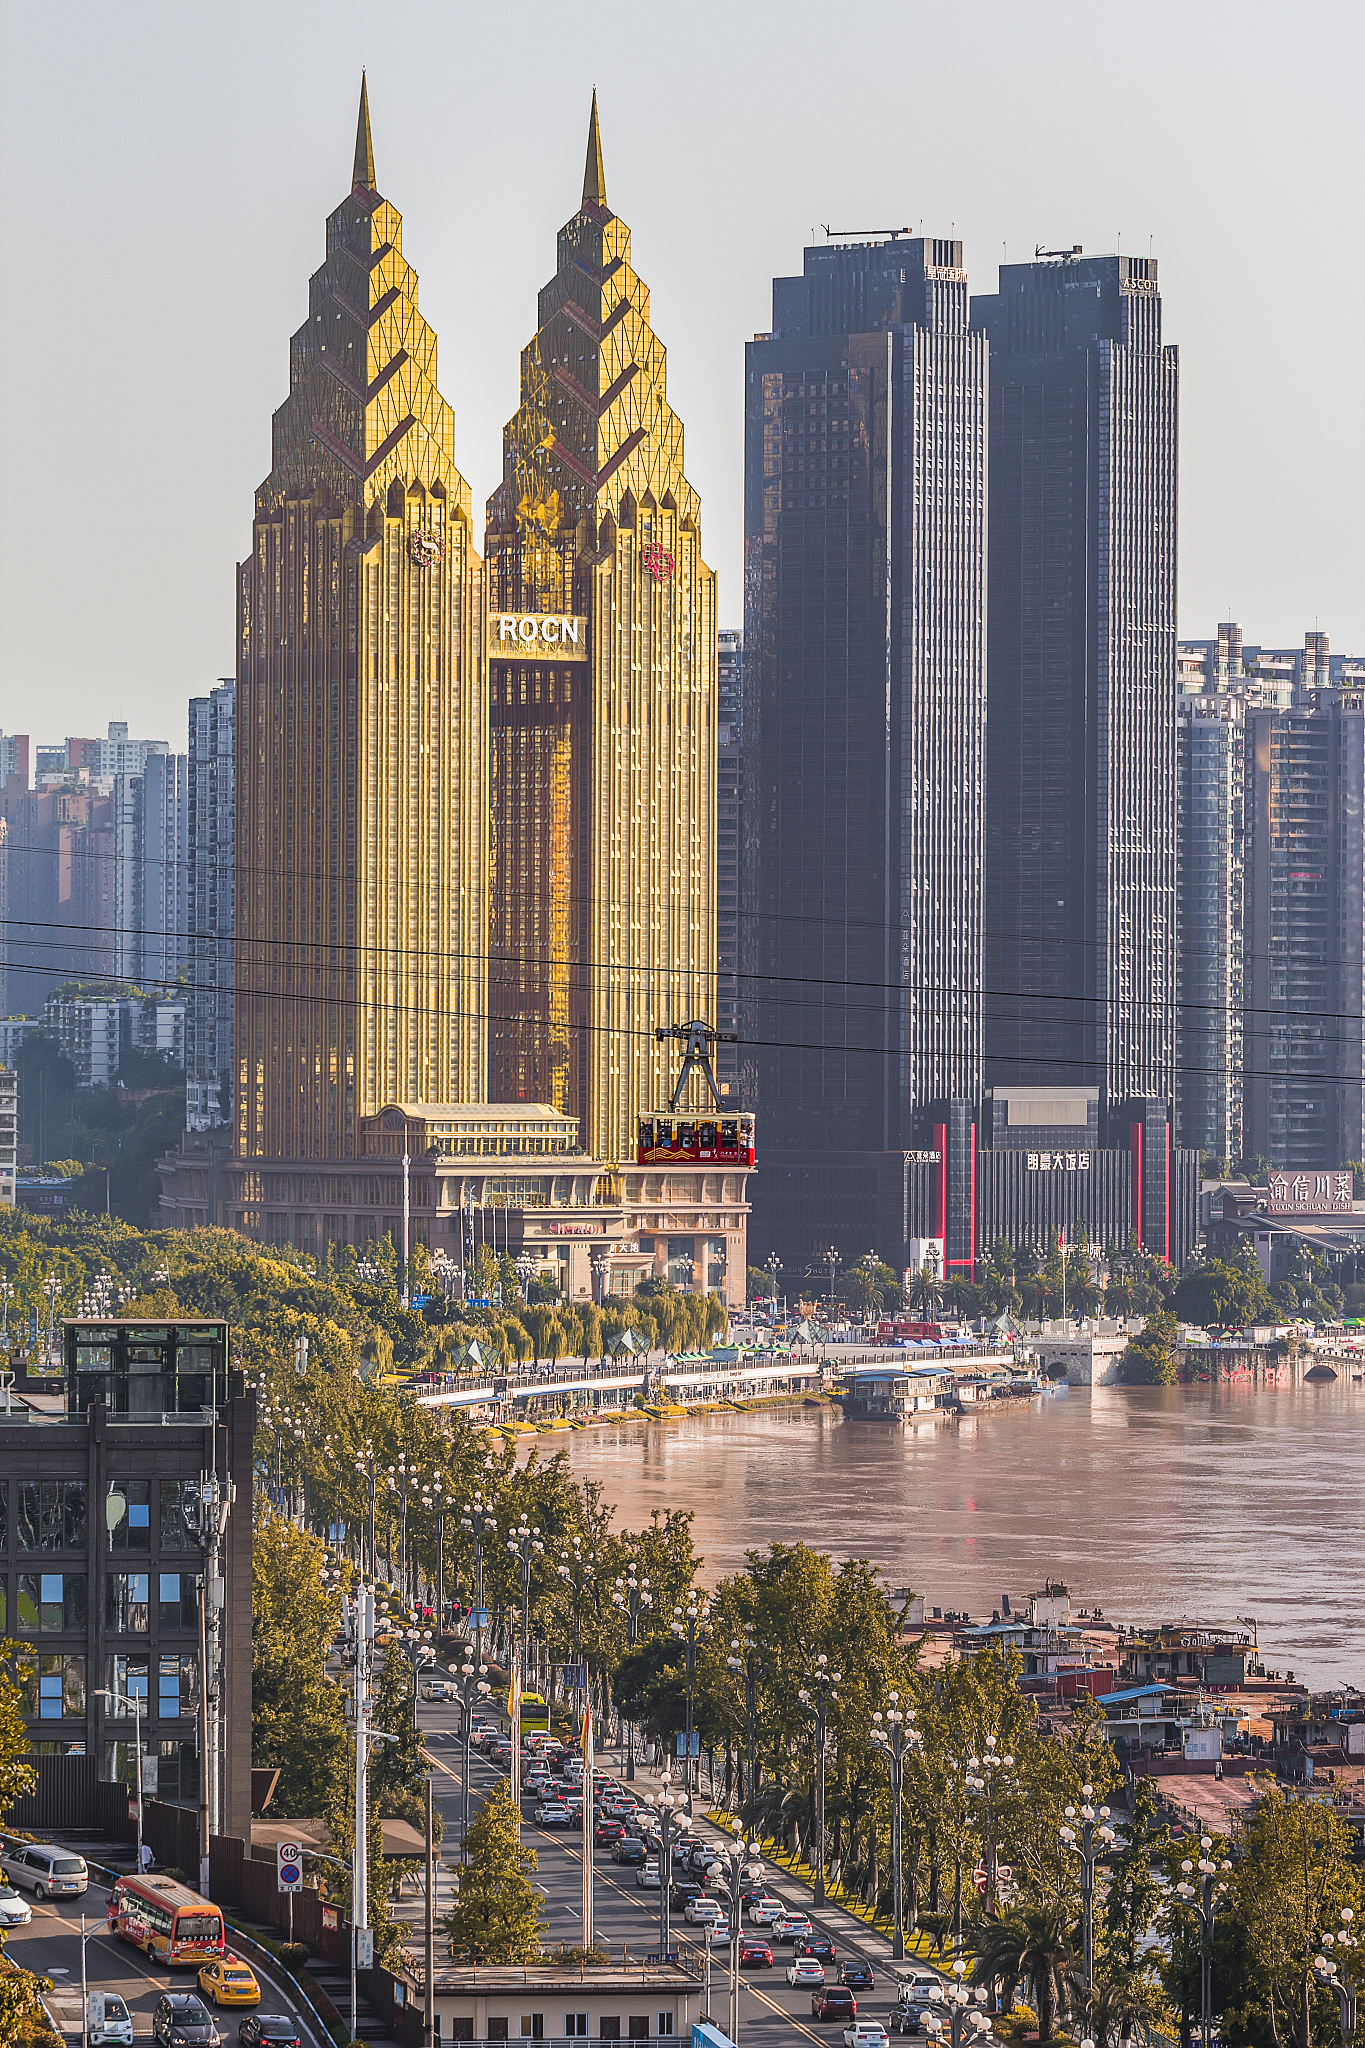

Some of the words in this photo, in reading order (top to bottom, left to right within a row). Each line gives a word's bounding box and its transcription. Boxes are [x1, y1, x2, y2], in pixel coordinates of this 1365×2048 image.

[1269, 1173, 1352, 1201] 渝信川菜
[1270, 1203, 1294, 1211] YUXIN
[1295, 1203, 1327, 1211] SICHUAN
[1331, 1202, 1350, 1210] DISH
[549, 1222, 604, 1235] Sheraton
[466, 1607, 472, 1617] 7
[283, 1848, 297, 1858] 40
